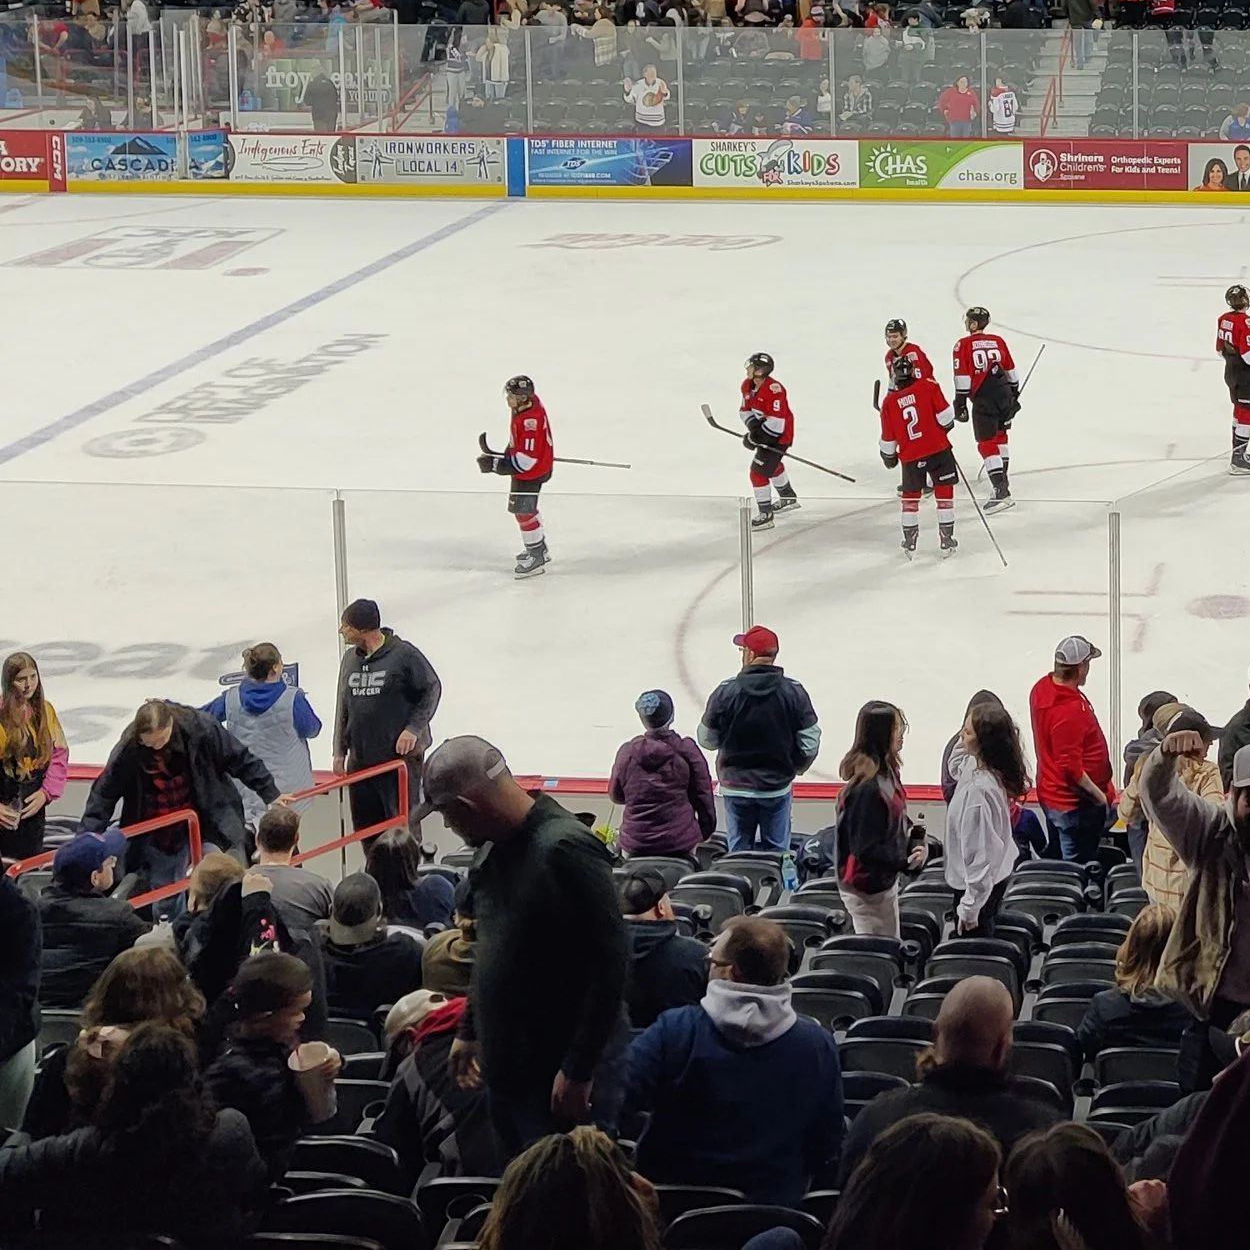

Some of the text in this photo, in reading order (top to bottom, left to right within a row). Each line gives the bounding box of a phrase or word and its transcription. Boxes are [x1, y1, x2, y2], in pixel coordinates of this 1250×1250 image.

[265, 65, 313, 104] froy
[238, 138, 327, 162] Indigenous Eats
[385, 141, 475, 155] IRONWORKERS
[551, 140, 575, 149] FIBER
[577, 140, 618, 149] INTERNET
[710, 141, 757, 152] SHARKEY'S
[52, 135, 62, 181] CCM
[1059, 153, 1104, 163] Shriners
[1111, 156, 1181, 165] Orthopedic Experts
[402, 160, 458, 173] LOCAL 14
[699, 150, 840, 186] CUTS FOR KIDS
[873, 152, 928, 180] CHAS
[1059, 162, 1106, 172] Children's
[1111, 166, 1181, 174] For Kids and Teens!
[958, 170, 1018, 185] chas.org
[773, 399, 781, 412] 9
[902, 406, 923, 441] 2
[525, 438, 535, 451] 11
